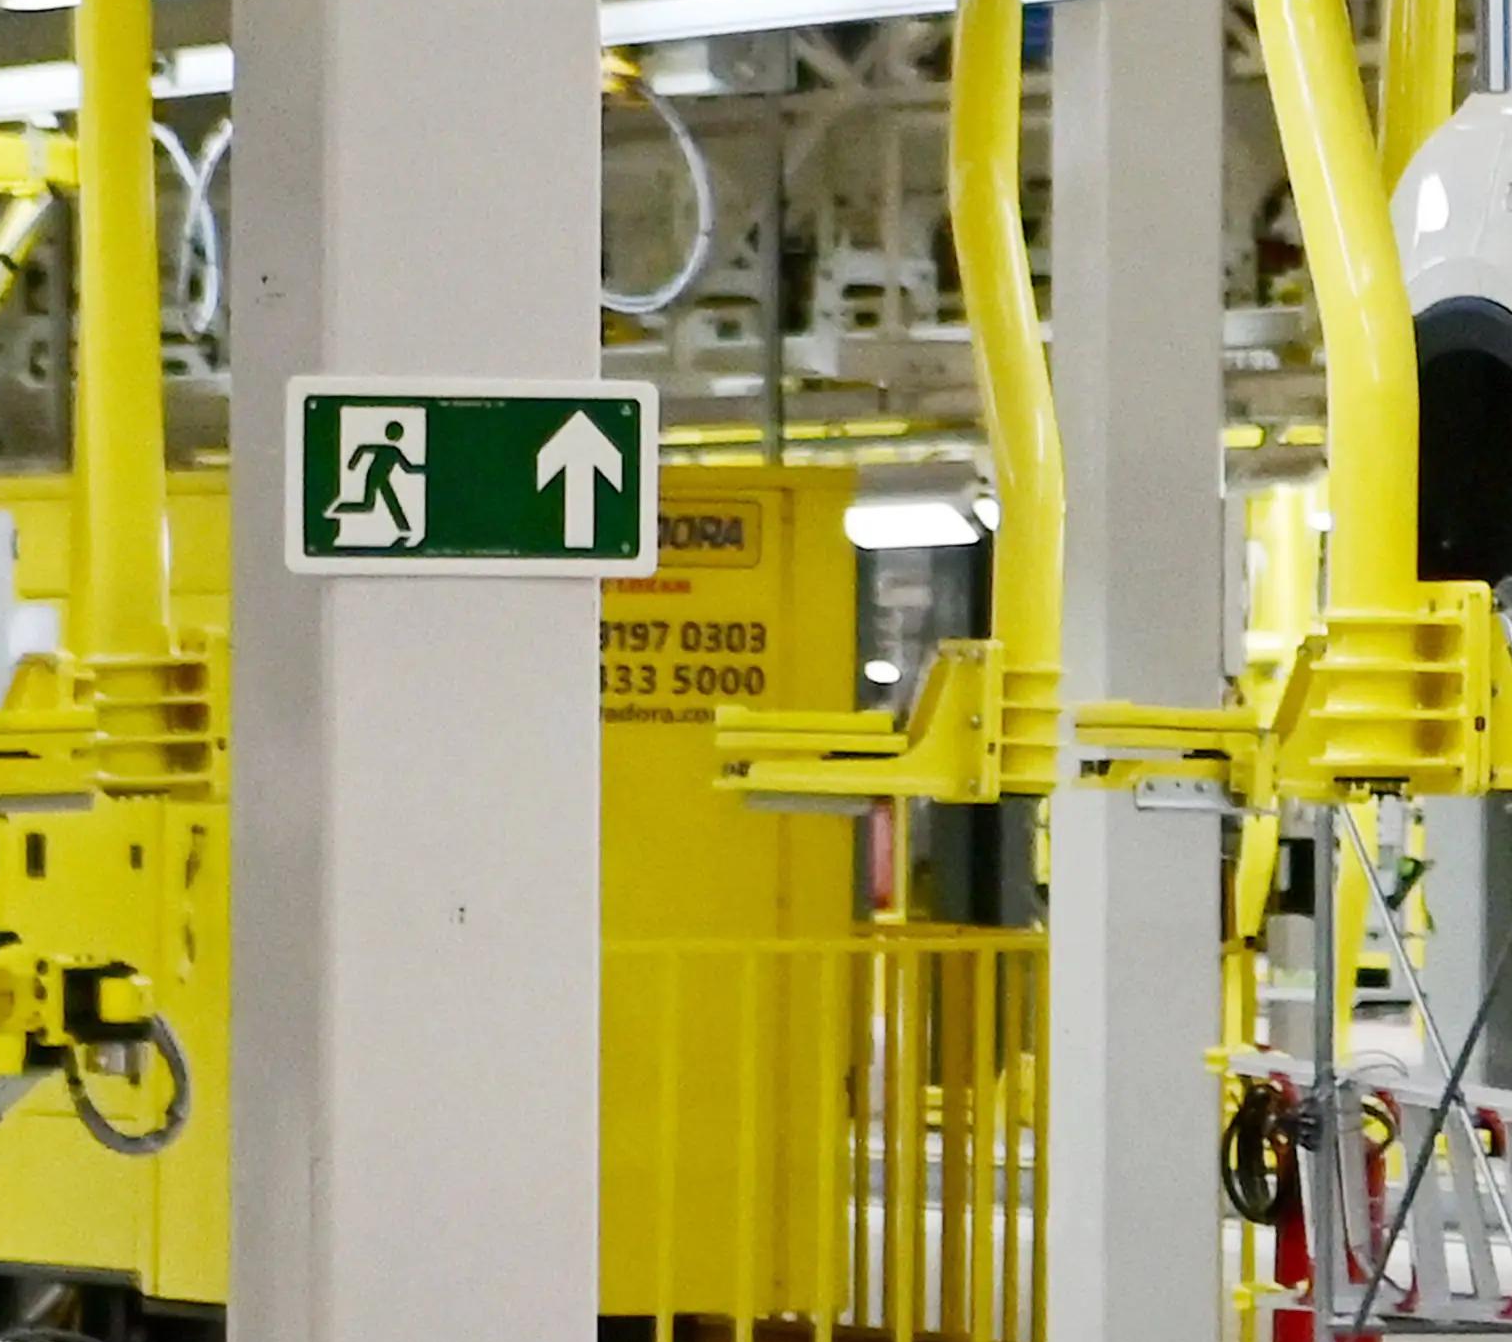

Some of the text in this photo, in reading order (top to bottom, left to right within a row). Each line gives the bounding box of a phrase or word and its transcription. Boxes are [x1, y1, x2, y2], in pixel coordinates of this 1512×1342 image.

[680, 620, 767, 654] 0303
[671, 664, 766, 697] 5000
[600, 703, 716, 724] adora.co
